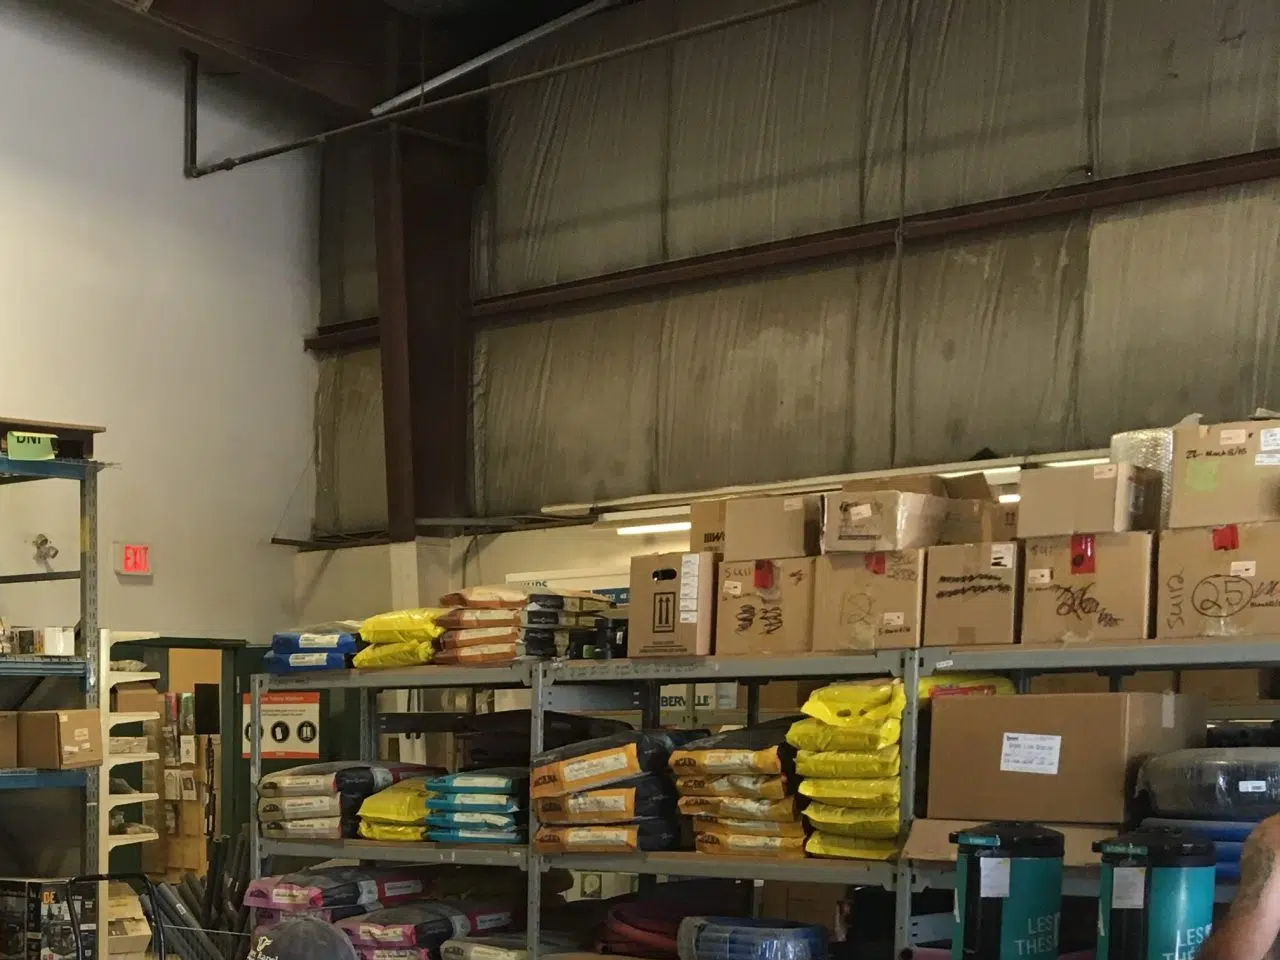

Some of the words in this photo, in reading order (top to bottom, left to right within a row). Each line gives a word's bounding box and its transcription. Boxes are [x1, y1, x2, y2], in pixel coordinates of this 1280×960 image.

[124, 544, 150, 572] EXIT
[1199, 580, 1243, 611] 25
[1027, 915, 1053, 934] LES
[1176, 927, 1204, 946] LES
